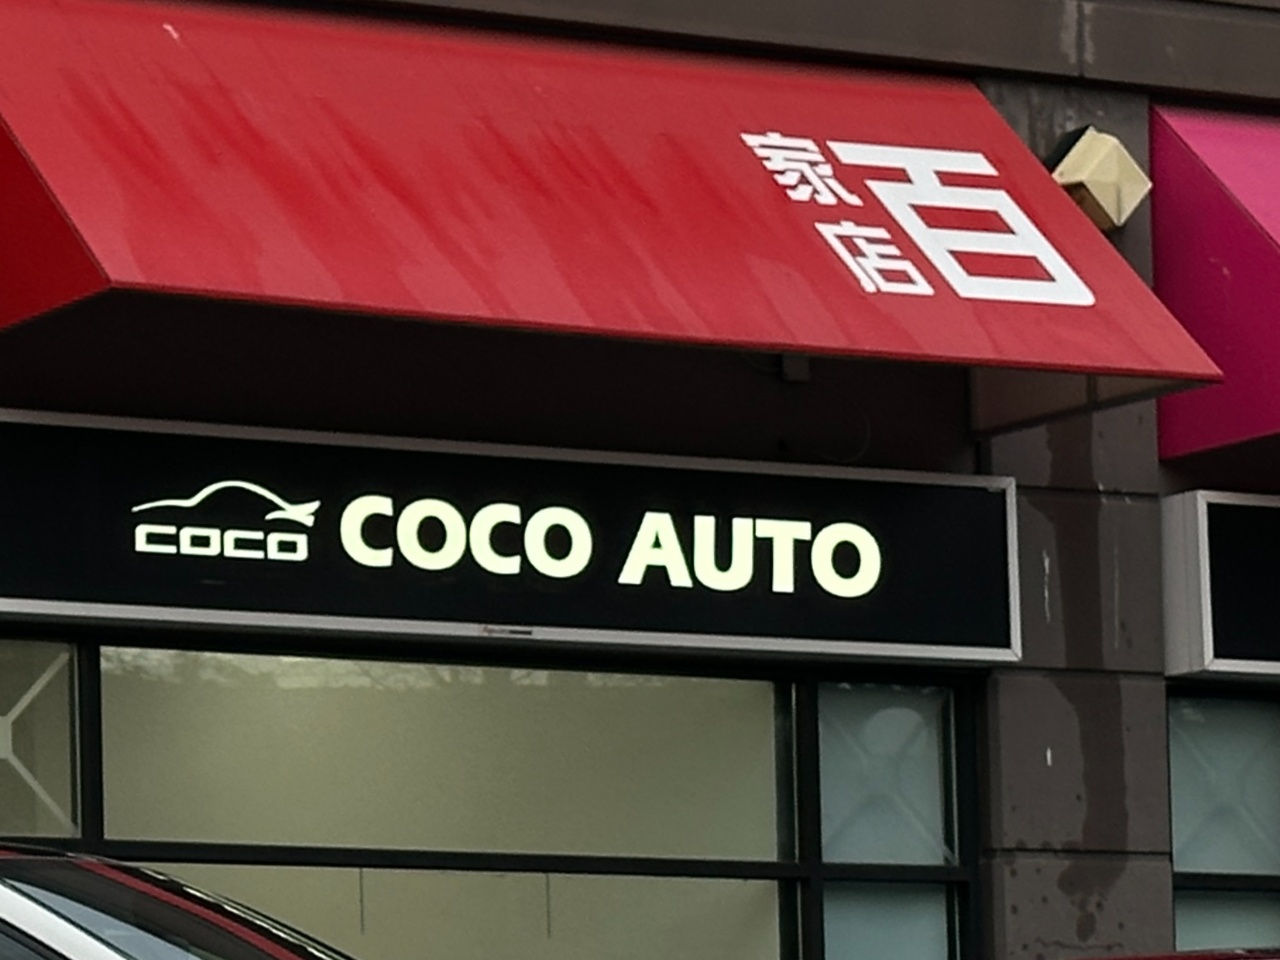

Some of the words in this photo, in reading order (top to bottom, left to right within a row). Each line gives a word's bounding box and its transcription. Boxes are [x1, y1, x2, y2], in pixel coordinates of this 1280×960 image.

[825, 140, 1097, 307] 百
[134, 523, 309, 562] COCO
[339, 494, 594, 579] COCO
[616, 510, 883, 598] AUTO
